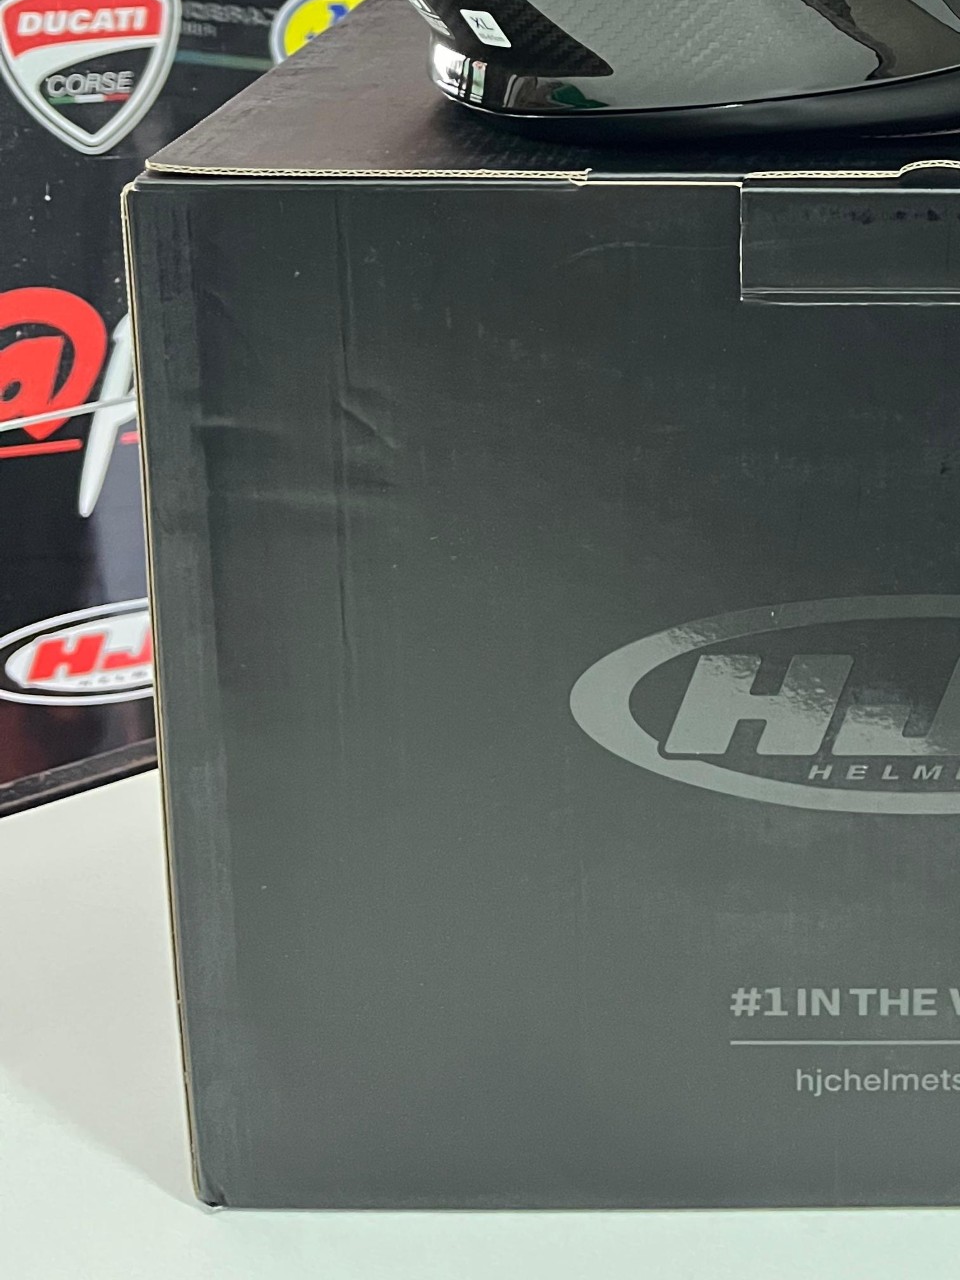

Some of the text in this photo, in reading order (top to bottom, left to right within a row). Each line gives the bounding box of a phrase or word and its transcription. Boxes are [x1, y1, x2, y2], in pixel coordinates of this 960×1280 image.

[17, 6, 147, 37] DUCATI
[469, 17, 495, 31] XL
[46, 71, 134, 97] CORSE
[730, 987, 788, 1017] #1
[797, 987, 841, 1017] IN
[849, 987, 938, 1016] THE
